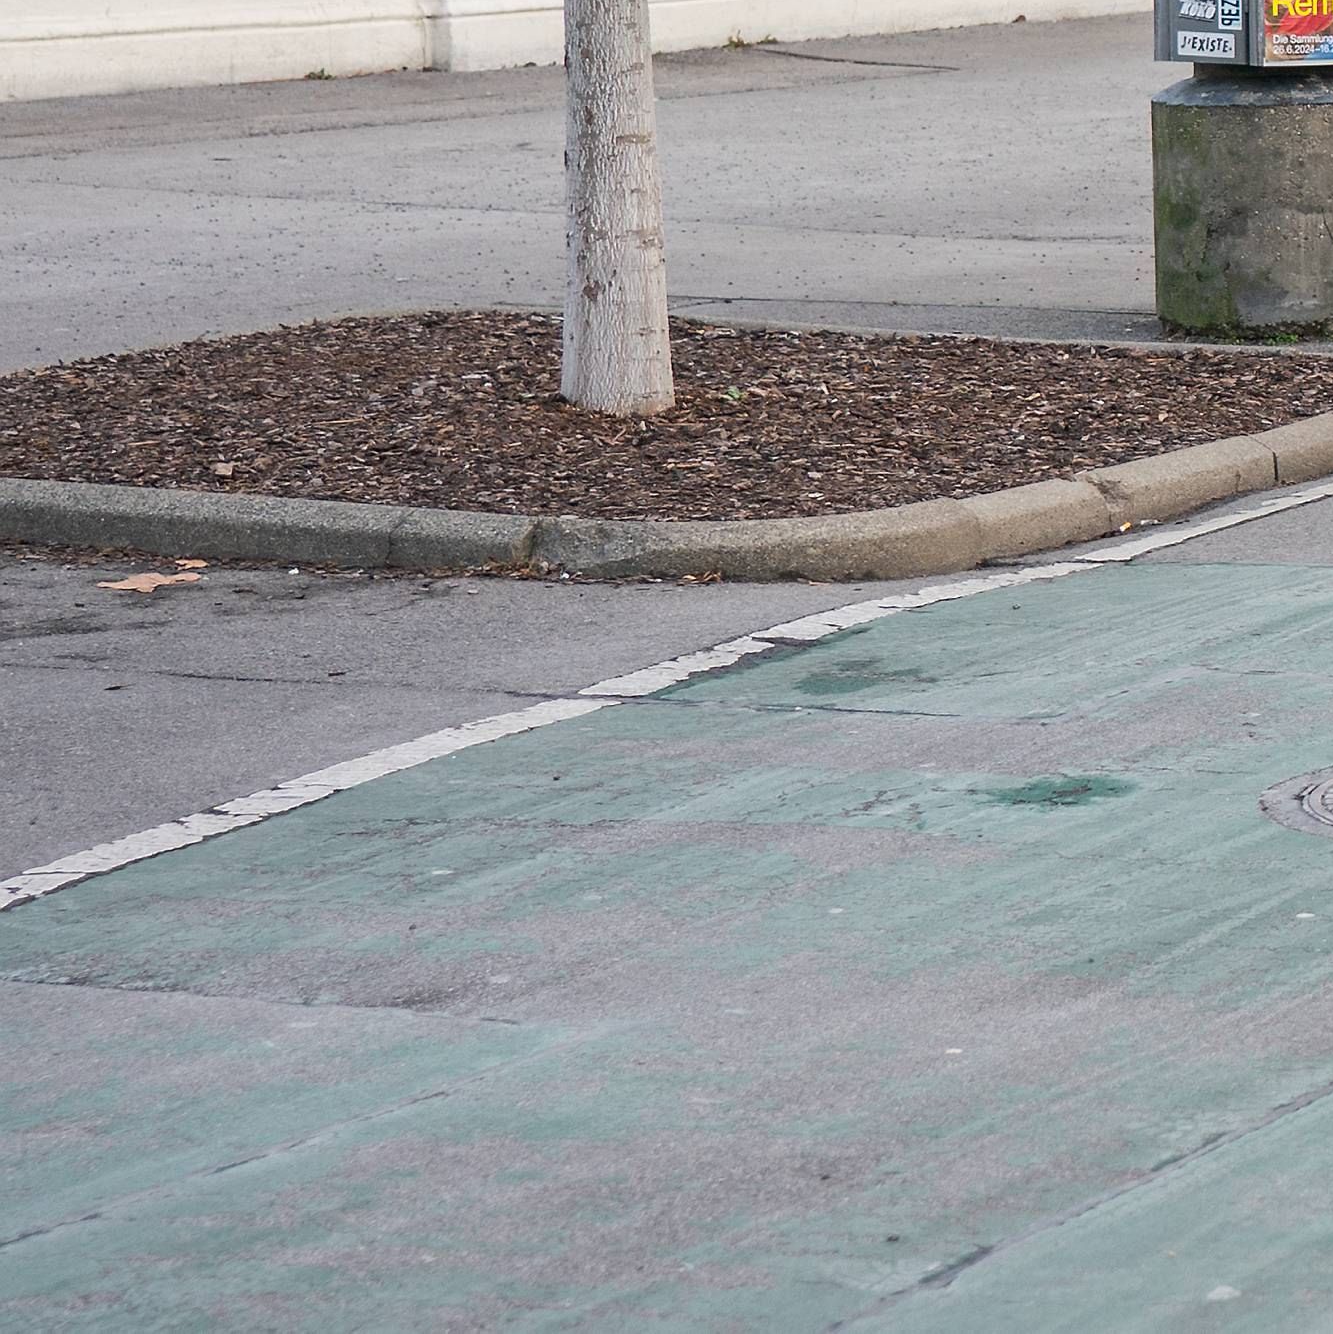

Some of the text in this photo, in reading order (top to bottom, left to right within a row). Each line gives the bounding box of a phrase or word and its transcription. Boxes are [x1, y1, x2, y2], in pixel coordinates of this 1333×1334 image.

[1180, 36, 1233, 53] J'EXISTE.
[1272, 34, 1287, 44] Die
[1288, 34, 1333, 46] Sammlung
